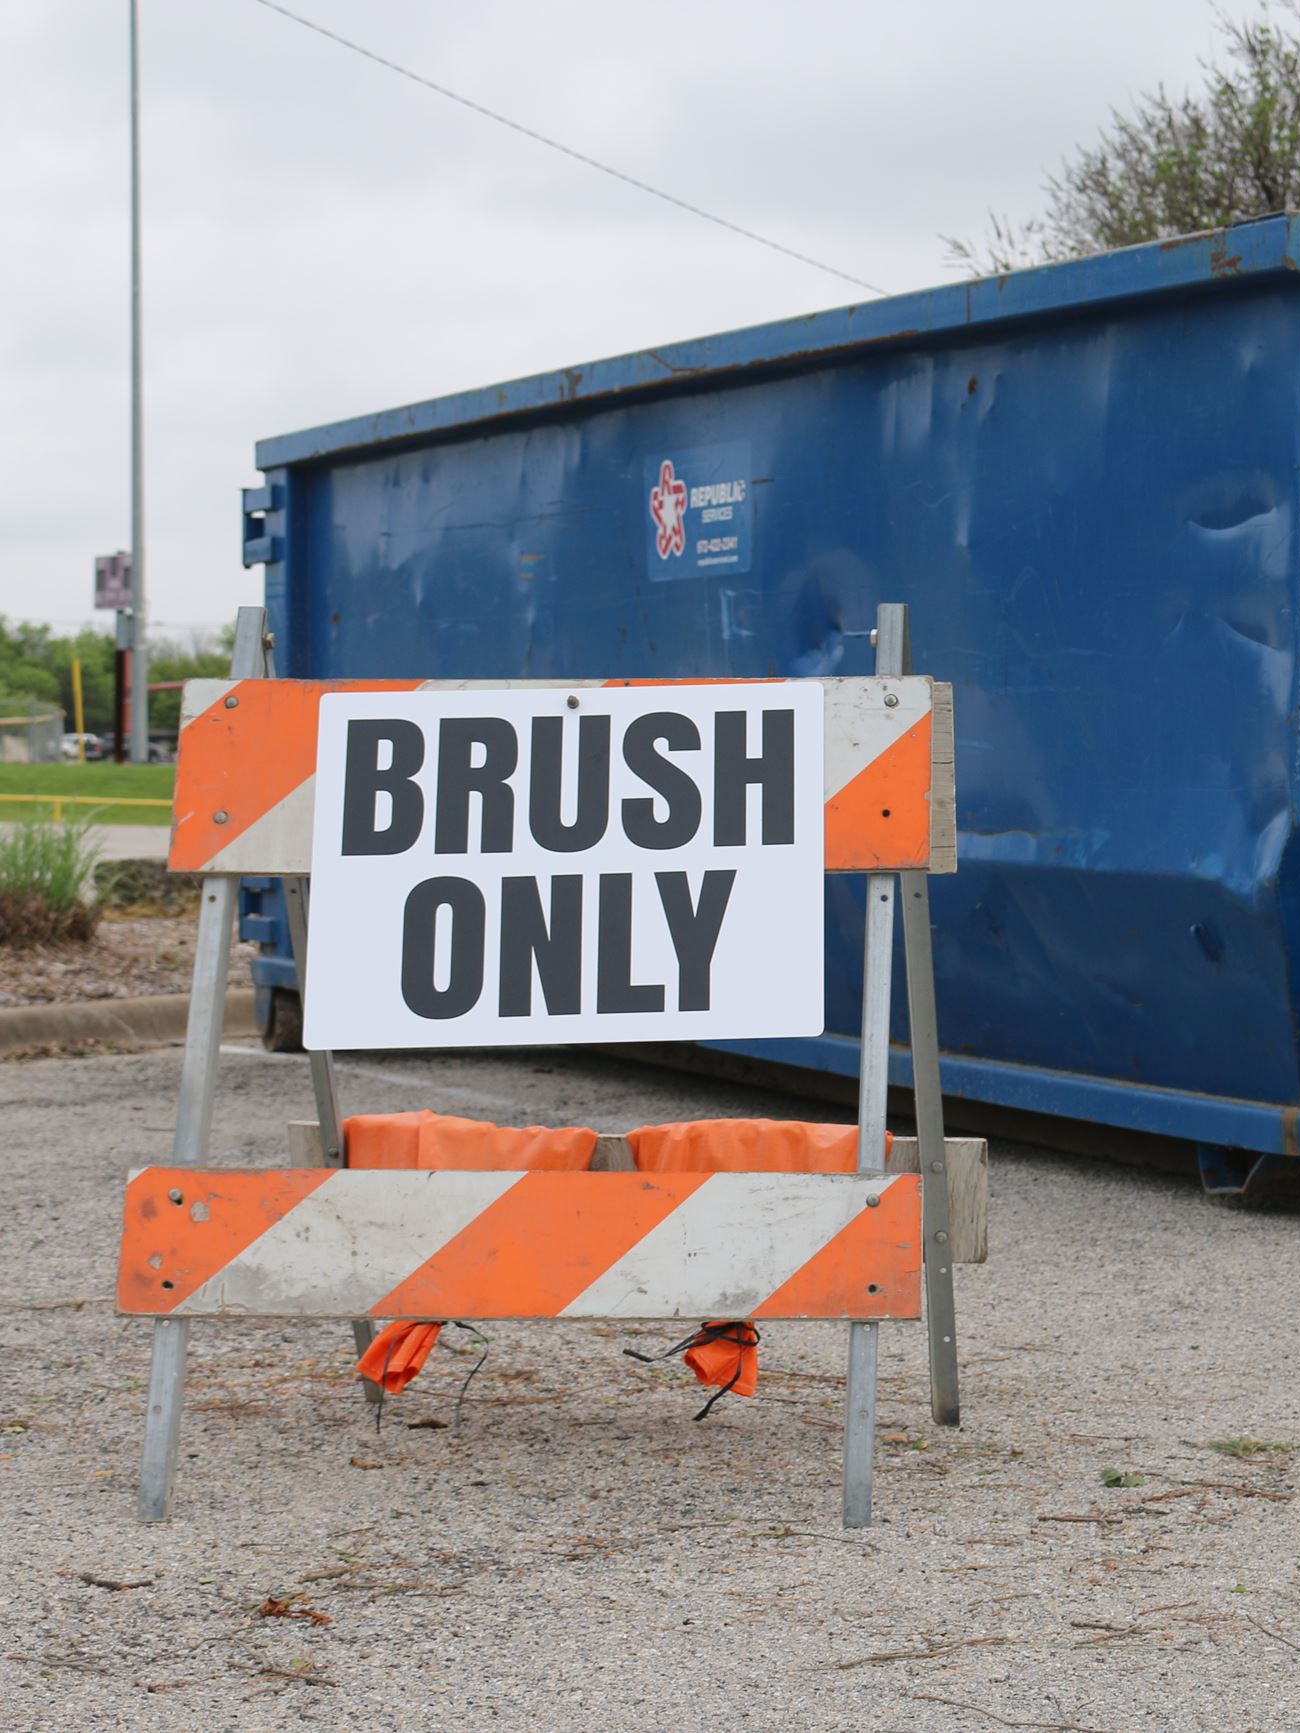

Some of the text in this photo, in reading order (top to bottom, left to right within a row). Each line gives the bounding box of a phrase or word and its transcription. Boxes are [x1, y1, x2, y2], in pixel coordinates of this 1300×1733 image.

[691, 481, 746, 507] REPUBLIC
[341, 709, 795, 856] BRUSH
[400, 869, 738, 1020] ONLY
